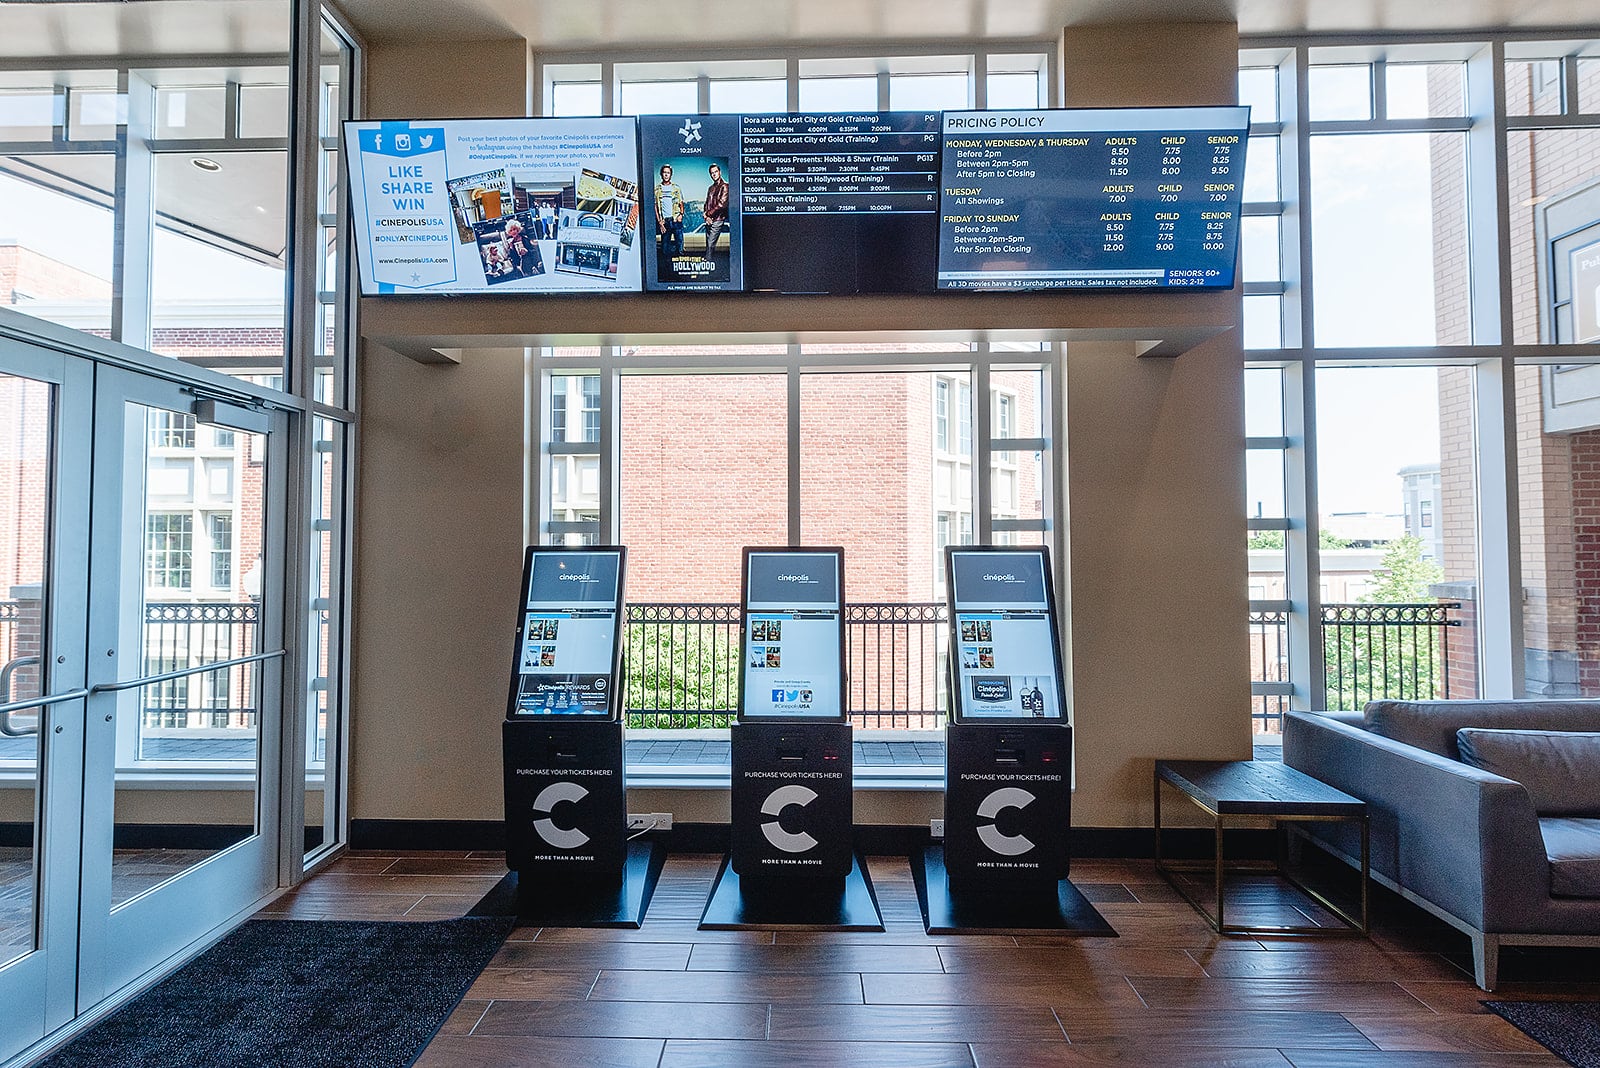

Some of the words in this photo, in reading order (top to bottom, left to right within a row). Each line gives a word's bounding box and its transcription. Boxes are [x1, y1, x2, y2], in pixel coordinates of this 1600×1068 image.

[805, 116, 818, 125] City
[845, 116, 879, 124] (Training)
[948, 118, 997, 128] PRICING
[1001, 117, 1045, 127] POLICY
[805, 136, 818, 145] City
[845, 136, 879, 144] (Training)
[946, 140, 982, 148] MONDAY,
[984, 139, 1037, 148] WEDNESDAY,
[1046, 138, 1090, 146] THURSDAY
[1208, 136, 1239, 144] SENIOR
[957, 150, 982, 158] Before
[984, 150, 1002, 158] 2pm
[1111, 148, 1129, 156] 8.50
[1165, 147, 1181, 155] 7.75
[1214, 146, 1230, 154] 7.75
[992, 159, 1029, 168] 2pm-5pm
[1212, 156, 1229, 164] 8.25
[389, 166, 423, 178] LIKE
[956, 170, 976, 178] After
[978, 170, 995, 179] 5pm
[1007, 169, 1036, 178] Closing
[1109, 168, 1128, 176] 11.50
[1162, 167, 1180, 175] 8.00
[763, 176, 781, 184] Upon
[814, 176, 850, 184] Hollywood
[381, 182, 434, 194] SHARE
[1103, 185, 1134, 193] ADULTS
[1157, 184, 1183, 192] CHILD
[392, 198, 425, 210] WIN
[785, 196, 817, 204] (Training)
[967, 197, 1004, 206] Showings
[1109, 195, 1127, 203] 7.00
[1160, 194, 1178, 202] 7.00
[375, 219, 444, 227] #CINEPOLISUSA
[943, 215, 972, 223] FRIDAY
[1100, 213, 1132, 221] ADULTS
[981, 225, 998, 234] 2pm
[1207, 222, 1223, 230] 8.25
[375, 234, 448, 242] #ONLYATCINEPOLIS
[988, 236, 1025, 244] 2pm-5pm
[1158, 233, 1173, 241] 7.75
[974, 246, 992, 254] 5pm
[1003, 245, 1031, 254] Closing
[1156, 243, 1174, 251] 9.00
[378, 257, 448, 265] www.CinepolisUSA.com
[673, 261, 716, 272] HOLLYWOOD
[1022, 280, 1053, 288] surcharge
[559, 574, 590, 582] cinépolis
[777, 574, 809, 582] cinépolis
[983, 574, 1015, 582] cinépolis
